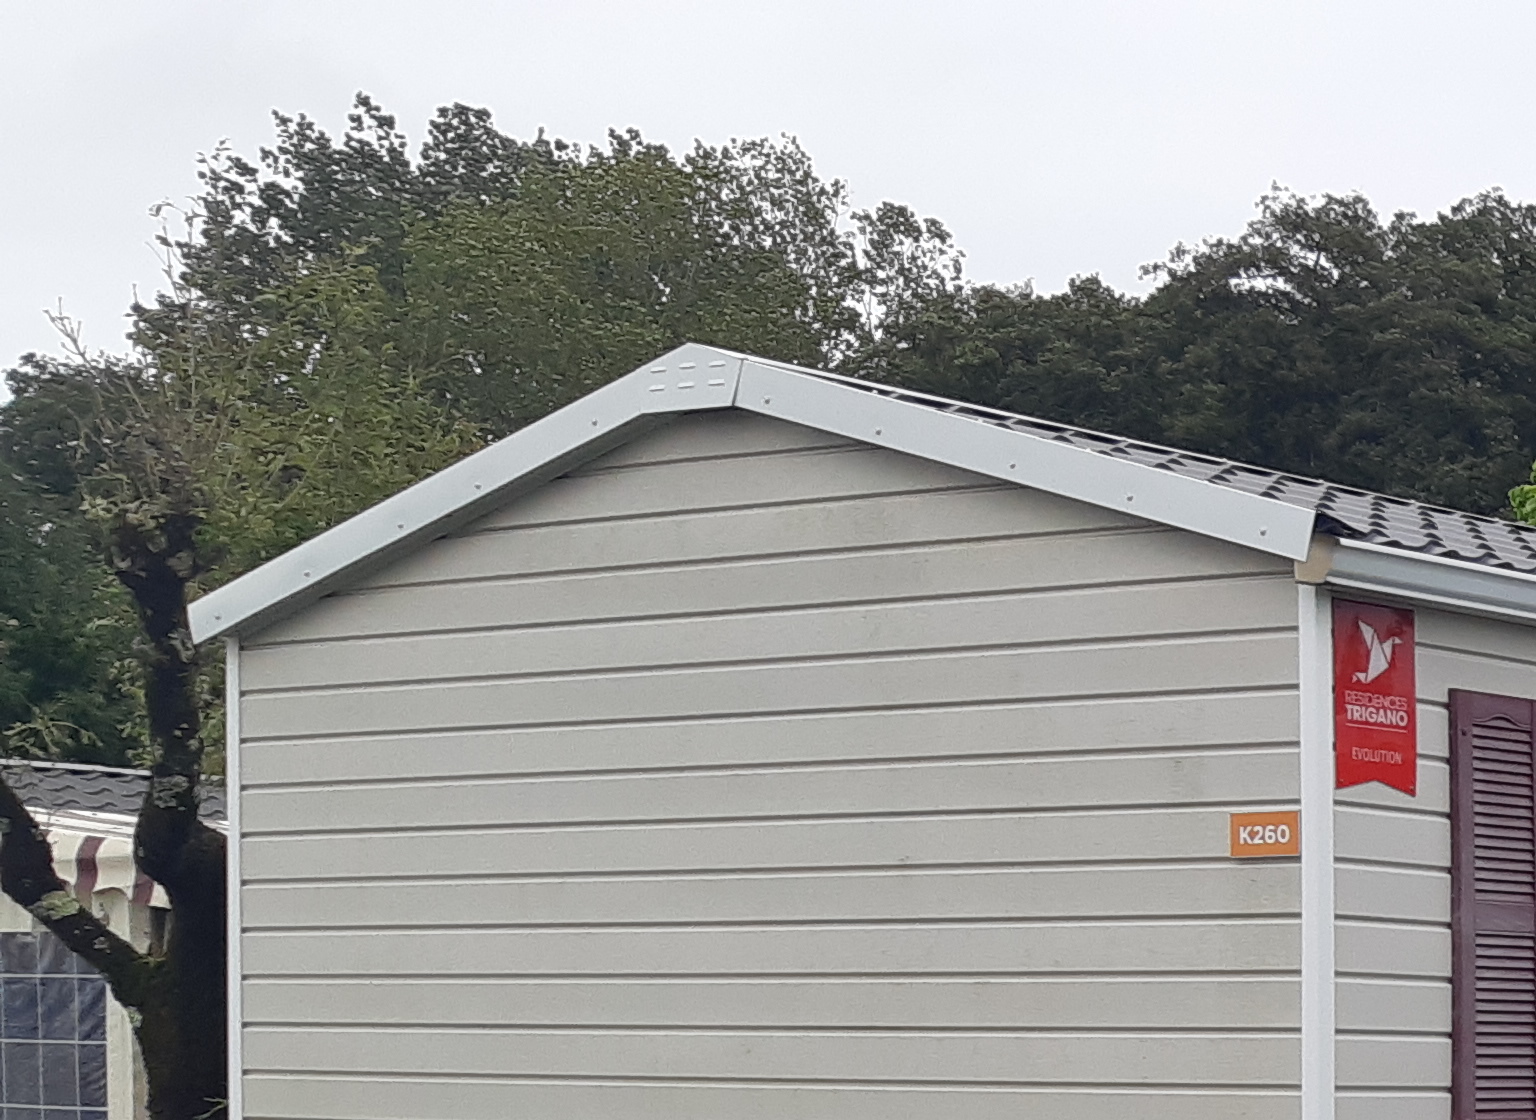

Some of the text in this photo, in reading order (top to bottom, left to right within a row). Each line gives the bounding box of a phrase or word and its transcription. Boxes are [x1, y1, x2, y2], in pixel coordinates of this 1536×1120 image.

[1345, 704, 1408, 726] TRIGANO
[1351, 747, 1402, 764] EVOLUTION
[1239, 824, 1290, 844] K260
